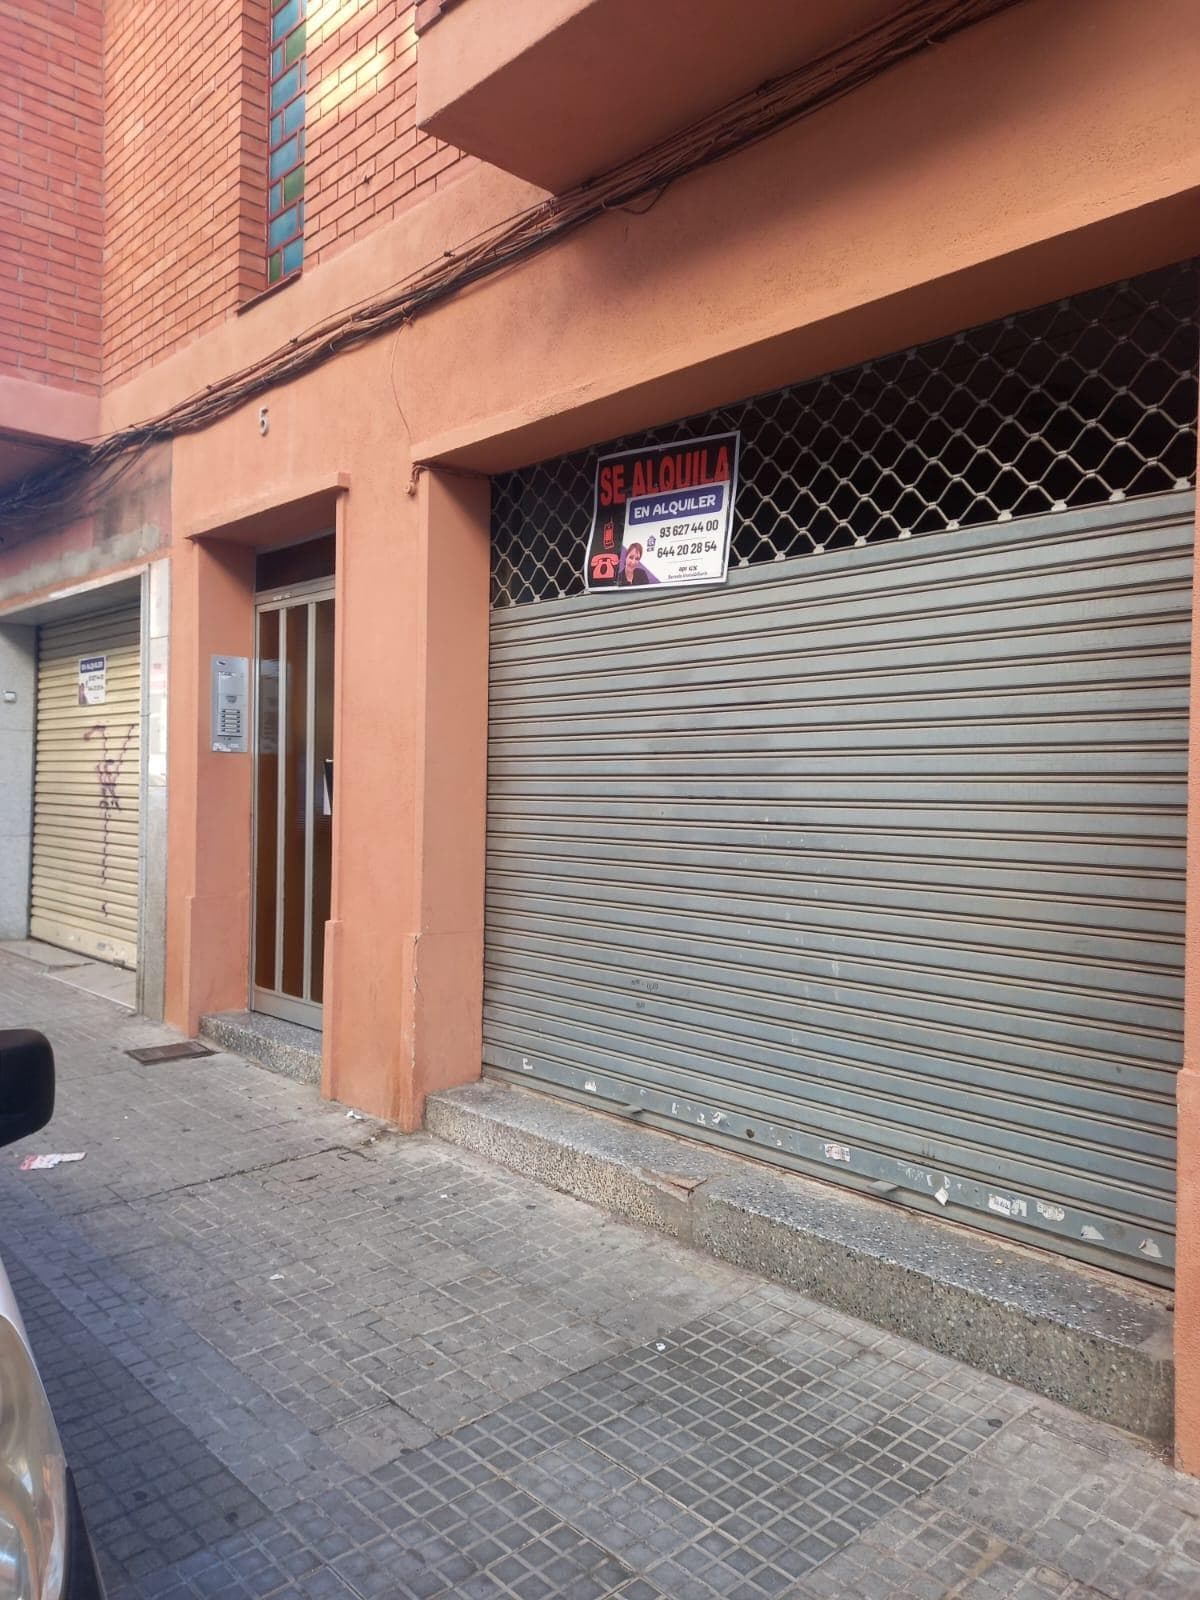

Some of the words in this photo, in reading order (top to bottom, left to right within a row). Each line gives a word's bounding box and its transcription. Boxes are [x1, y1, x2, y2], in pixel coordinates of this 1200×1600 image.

[601, 464, 626, 506] SE
[631, 446, 730, 497] ALQUILA
[634, 506, 650, 519] EN
[652, 494, 716, 516] ALQUILER
[659, 526, 671, 538] 93
[672, 524, 689, 537] 627
[691, 522, 704, 534] 44
[705, 519, 719, 532] 00
[657, 547, 675, 558] 644
[677, 544, 689, 556] 20
[690, 542, 703, 554] 28
[704, 541, 717, 552] 54
